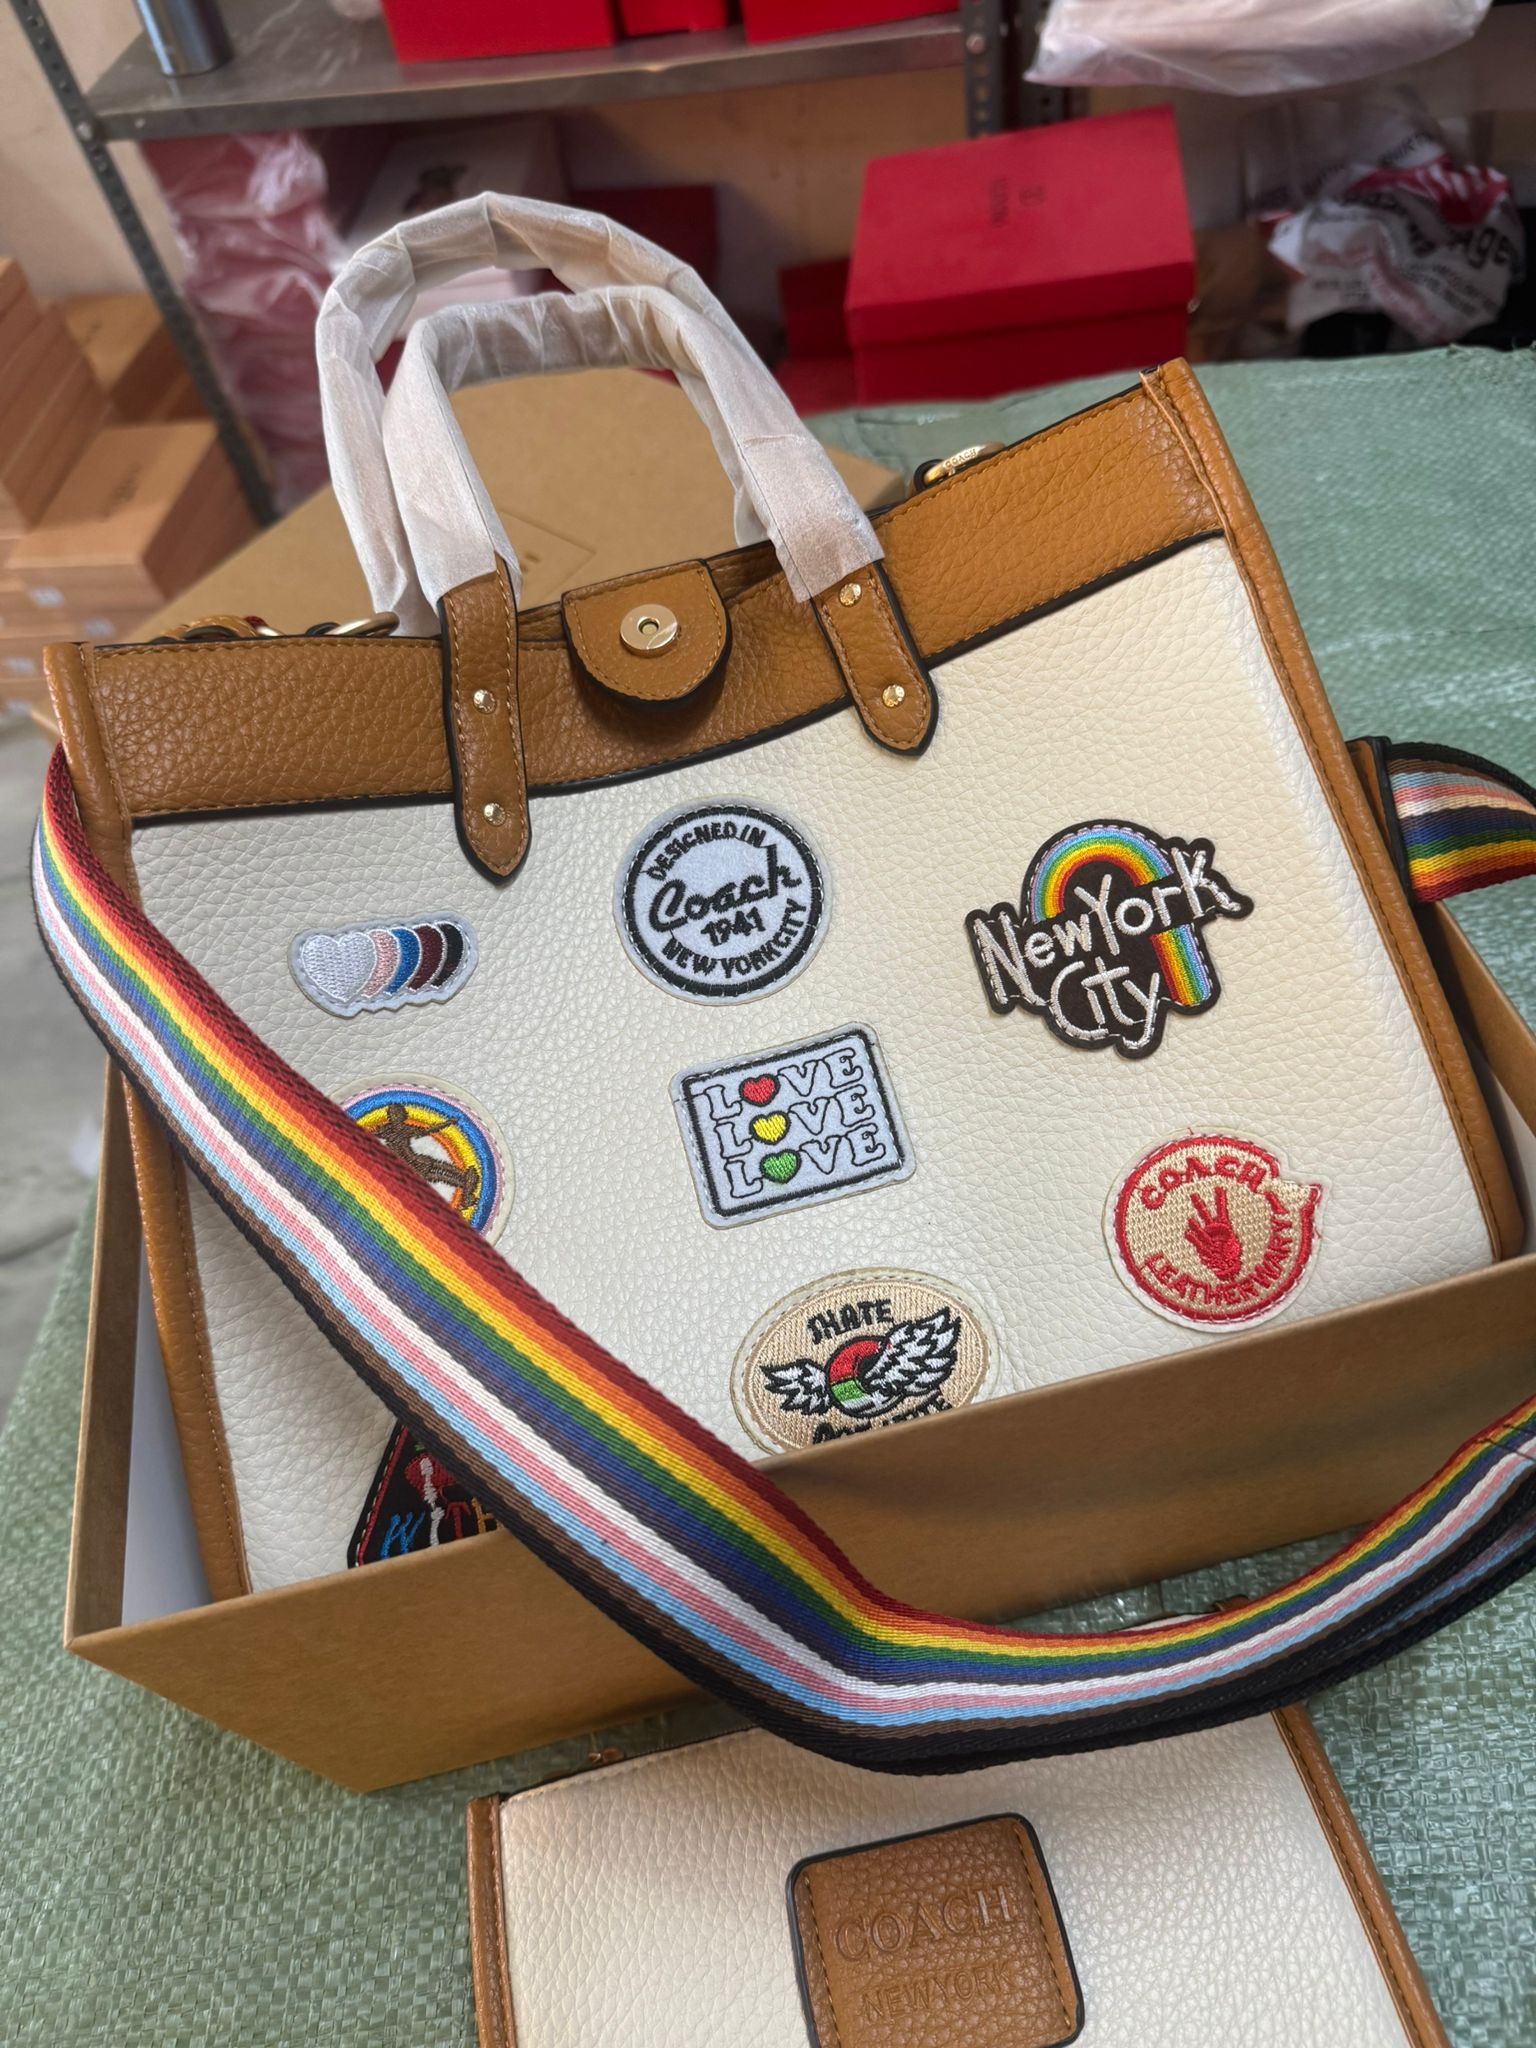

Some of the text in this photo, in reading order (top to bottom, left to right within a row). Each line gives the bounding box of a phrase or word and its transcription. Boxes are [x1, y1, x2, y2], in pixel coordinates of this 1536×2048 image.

[945, 448, 977, 469] COACH
[648, 820, 767, 882] DESIGNED IN
[648, 843, 802, 933] Coach
[700, 906, 767, 947] 1941
[974, 847, 1242, 1007] New York
[1050, 956, 1161, 1050] City
[1140, 1155, 1267, 1211] COACH
[834, 1885, 1014, 1962] COACH
